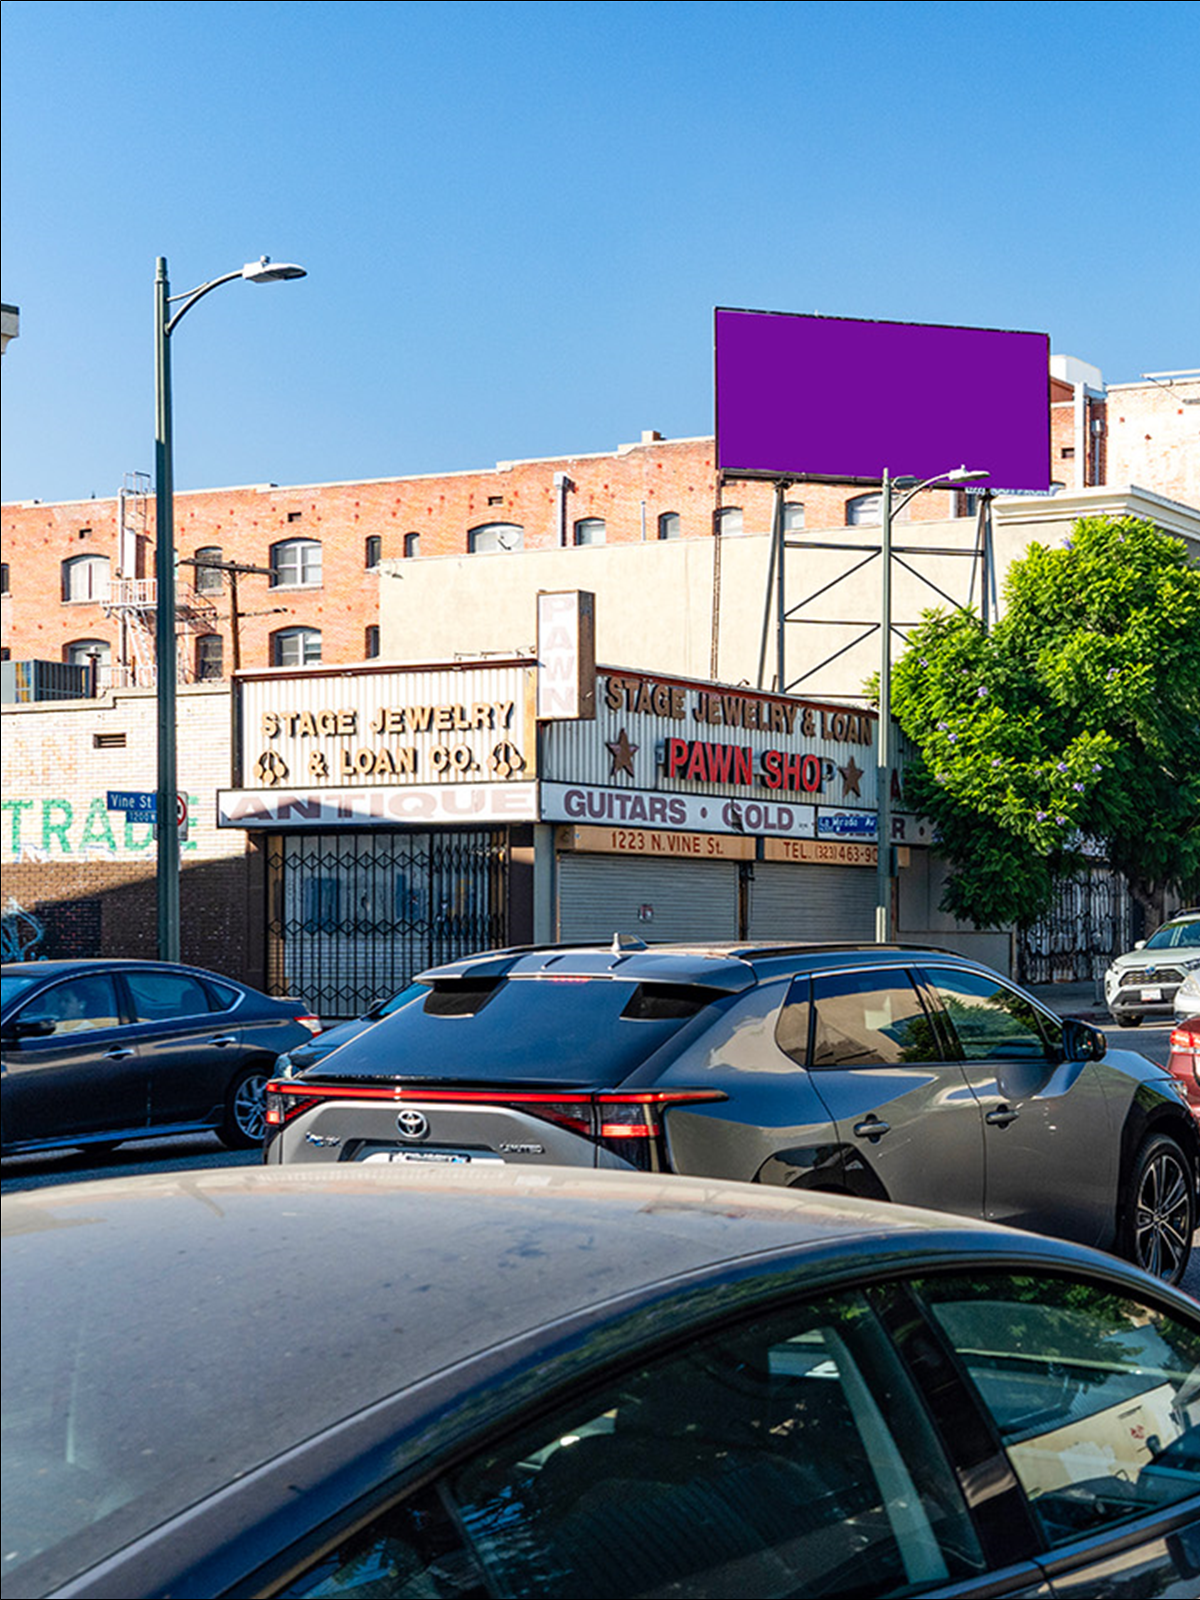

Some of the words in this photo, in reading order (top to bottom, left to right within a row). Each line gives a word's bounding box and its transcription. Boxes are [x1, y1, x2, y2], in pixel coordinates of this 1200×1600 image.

[541, 596, 577, 714] PAWN
[261, 708, 359, 740] STAGE
[369, 700, 514, 736] JEWELRY
[605, 677, 686, 720] STAGE
[692, 694, 798, 737] JEWELRY
[801, 708, 817, 738] &
[821, 711, 874, 747] LOAN
[307, 748, 329, 778] &
[340, 746, 417, 776] LOAN
[428, 743, 481, 774] CO.
[664, 737, 754, 787] PAWN
[760, 748, 839, 795] SHOP
[110, 793, 135, 808] Vine
[139, 795, 153, 809] St
[222, 787, 534, 823] ANTIQUE
[563, 788, 688, 826] GUITARS
[721, 801, 795, 832] GOLD
[611, 831, 645, 851] 1223
[667, 834, 701, 853] VINE
[707, 837, 724, 855] St.
[783, 841, 811, 860] TEL.
[815, 844, 838, 861] (323)
